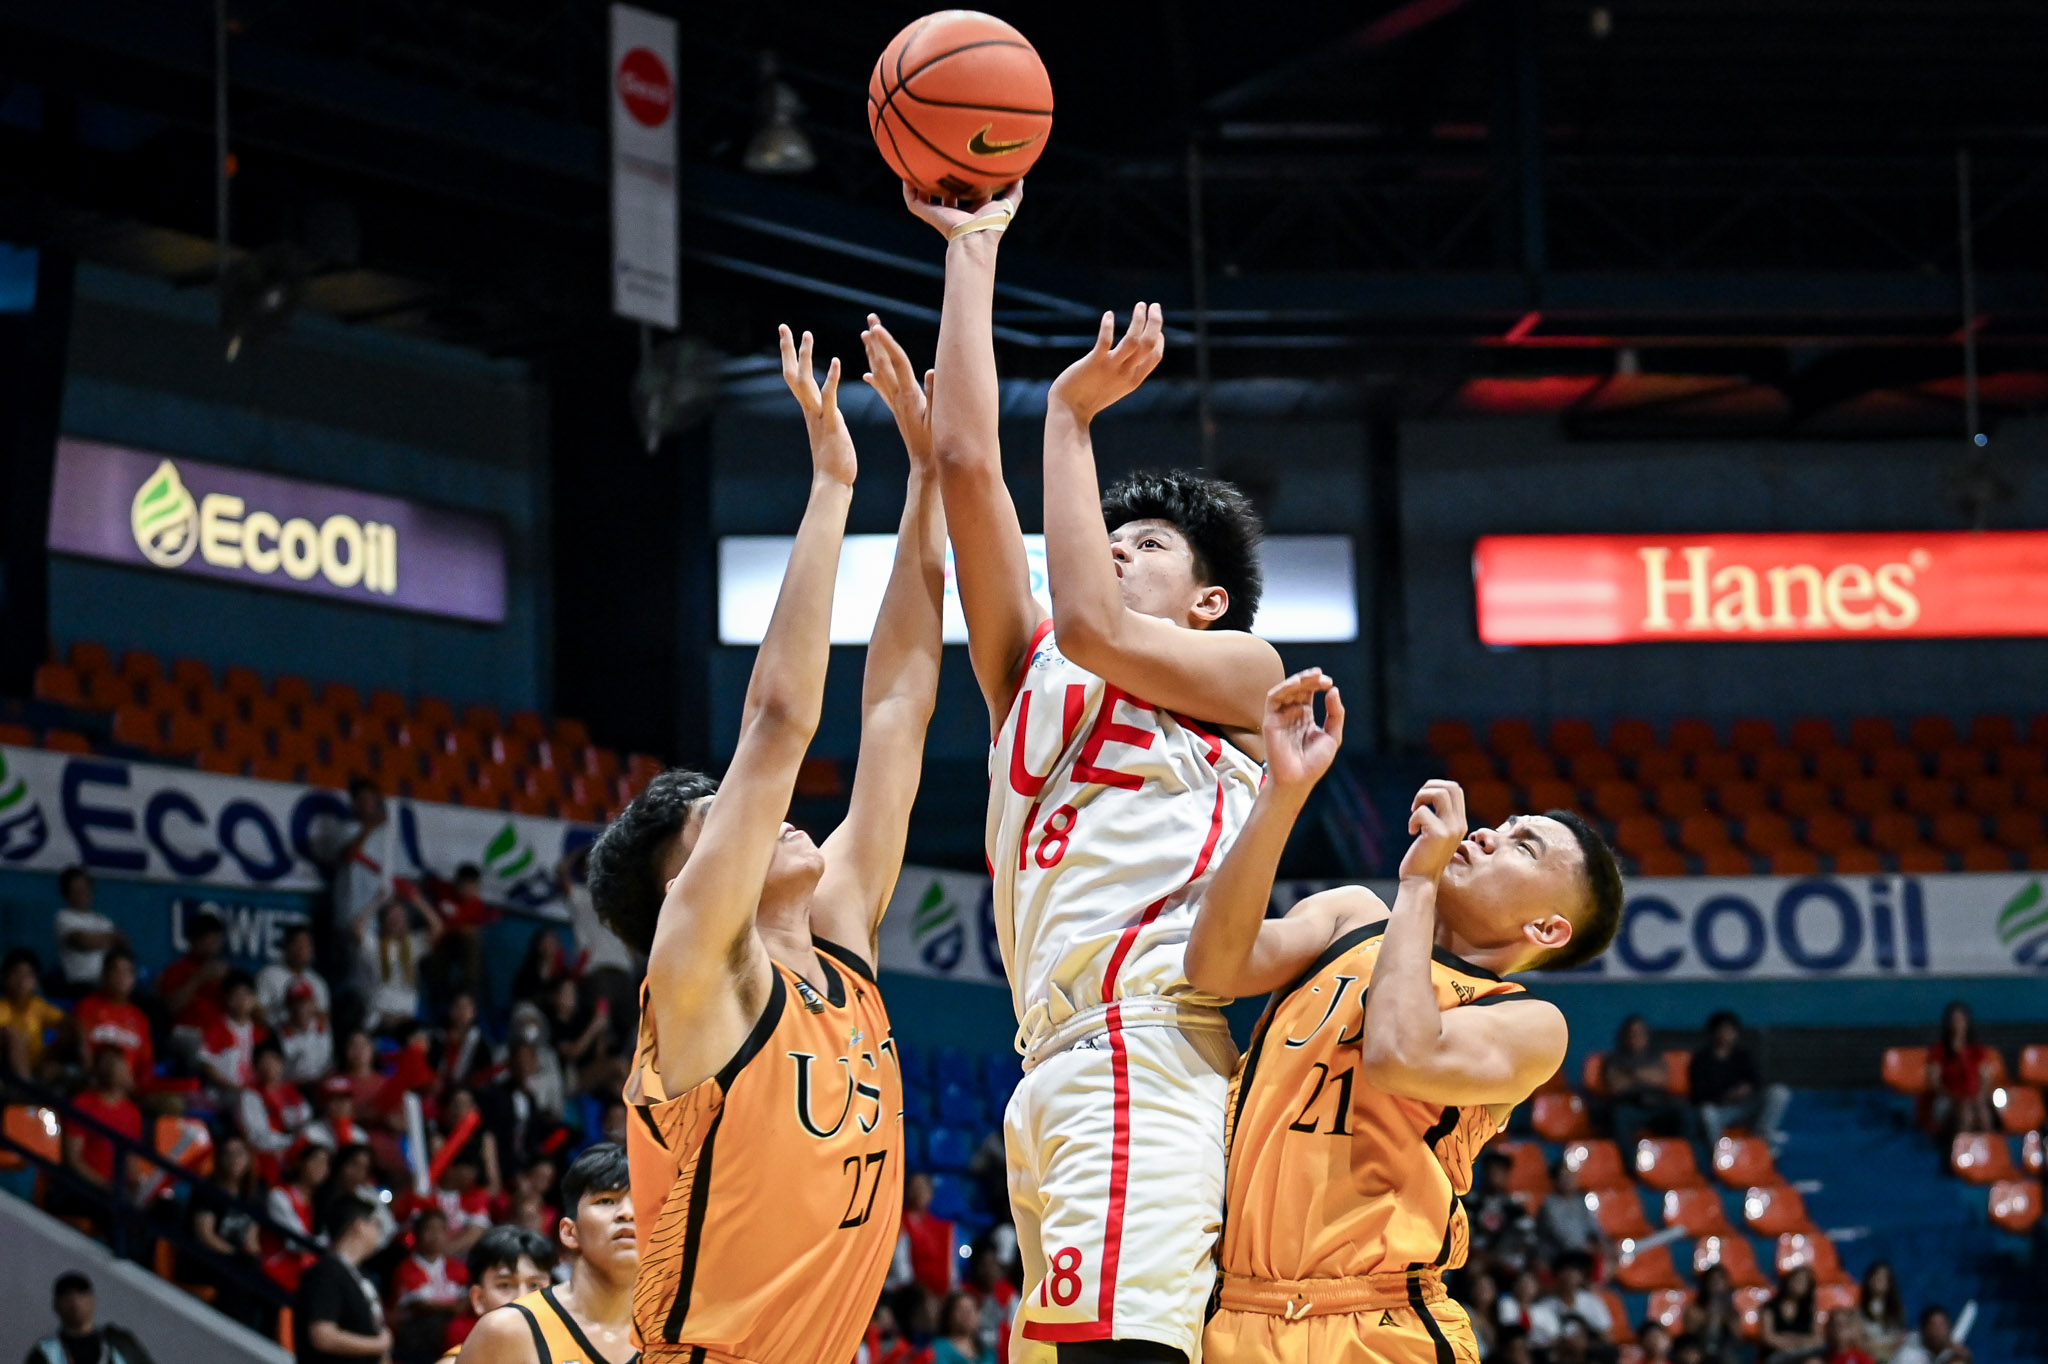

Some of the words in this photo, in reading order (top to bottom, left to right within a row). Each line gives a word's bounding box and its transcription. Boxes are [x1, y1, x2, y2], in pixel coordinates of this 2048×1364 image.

[201, 492, 397, 596] EcoOil
[1639, 547, 1921, 632] Hanes
[1010, 683, 1156, 797] UE
[1019, 803, 1078, 871] 18
[1552, 875, 1929, 972] coOil
[1289, 1062, 1354, 1136] 21
[838, 1149, 888, 1229] 27
[1040, 1246, 1083, 1308] 18
